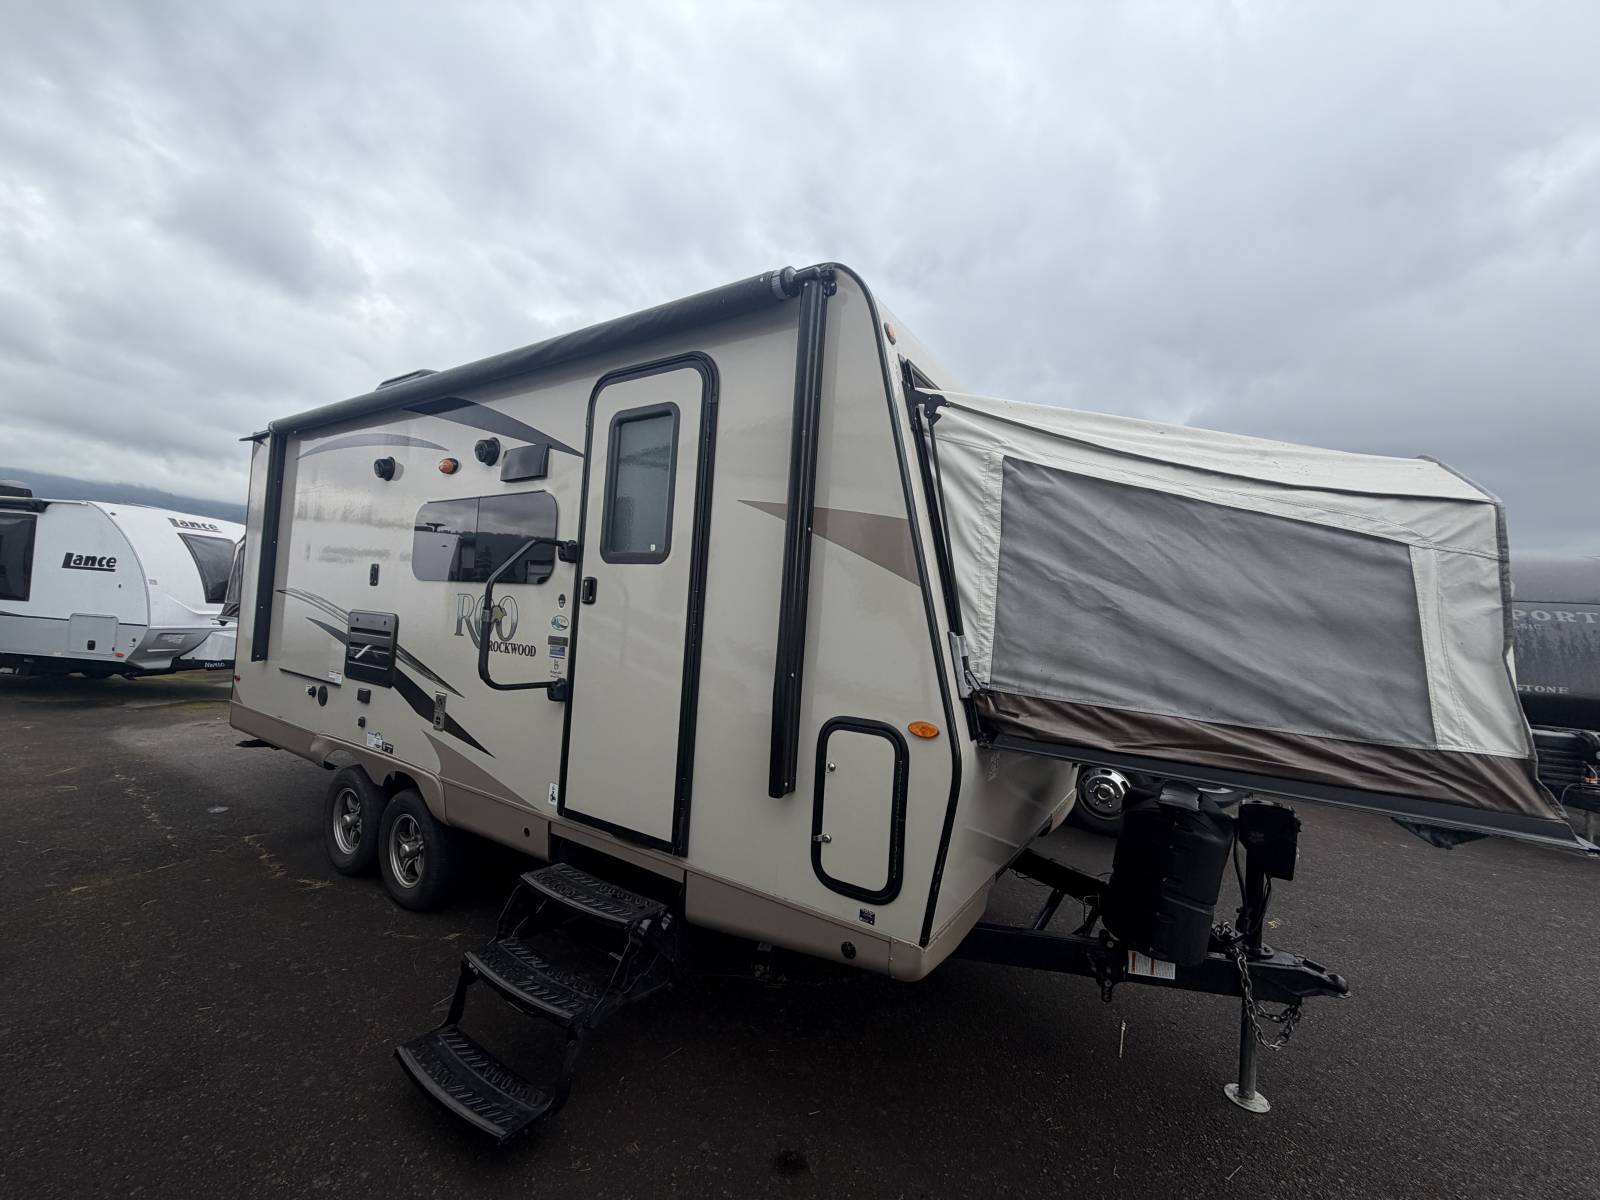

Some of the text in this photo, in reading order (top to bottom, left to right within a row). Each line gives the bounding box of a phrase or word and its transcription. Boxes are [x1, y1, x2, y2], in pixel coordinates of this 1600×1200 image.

[168, 517, 222, 533] Lance
[61, 551, 117, 572] Lance
[489, 640, 537, 657] ROCKWOOD
